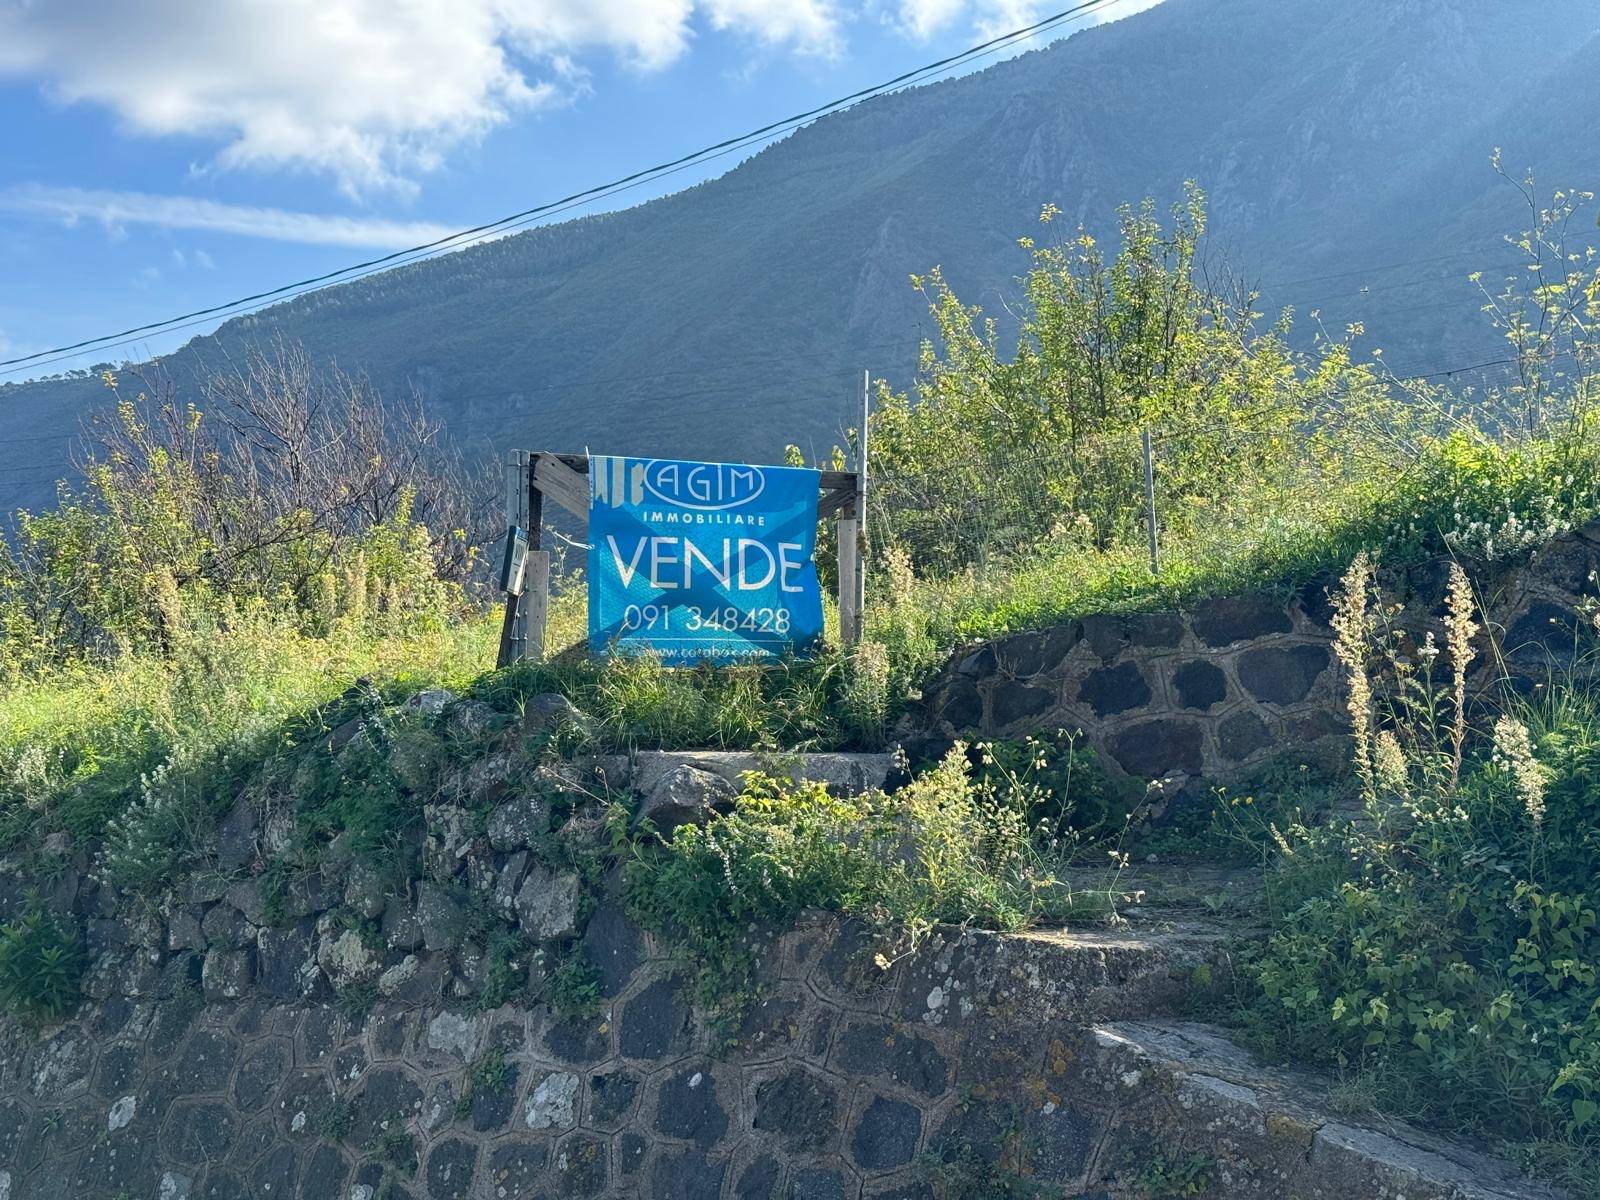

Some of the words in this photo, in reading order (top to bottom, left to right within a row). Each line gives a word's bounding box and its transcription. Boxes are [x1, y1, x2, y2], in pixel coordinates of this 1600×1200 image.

[656, 463, 754, 501] AGIM
[643, 511, 766, 527] IMMOBILIARE
[606, 535, 804, 592] VENDE
[624, 604, 669, 630] 091
[686, 606, 790, 633] 348428
